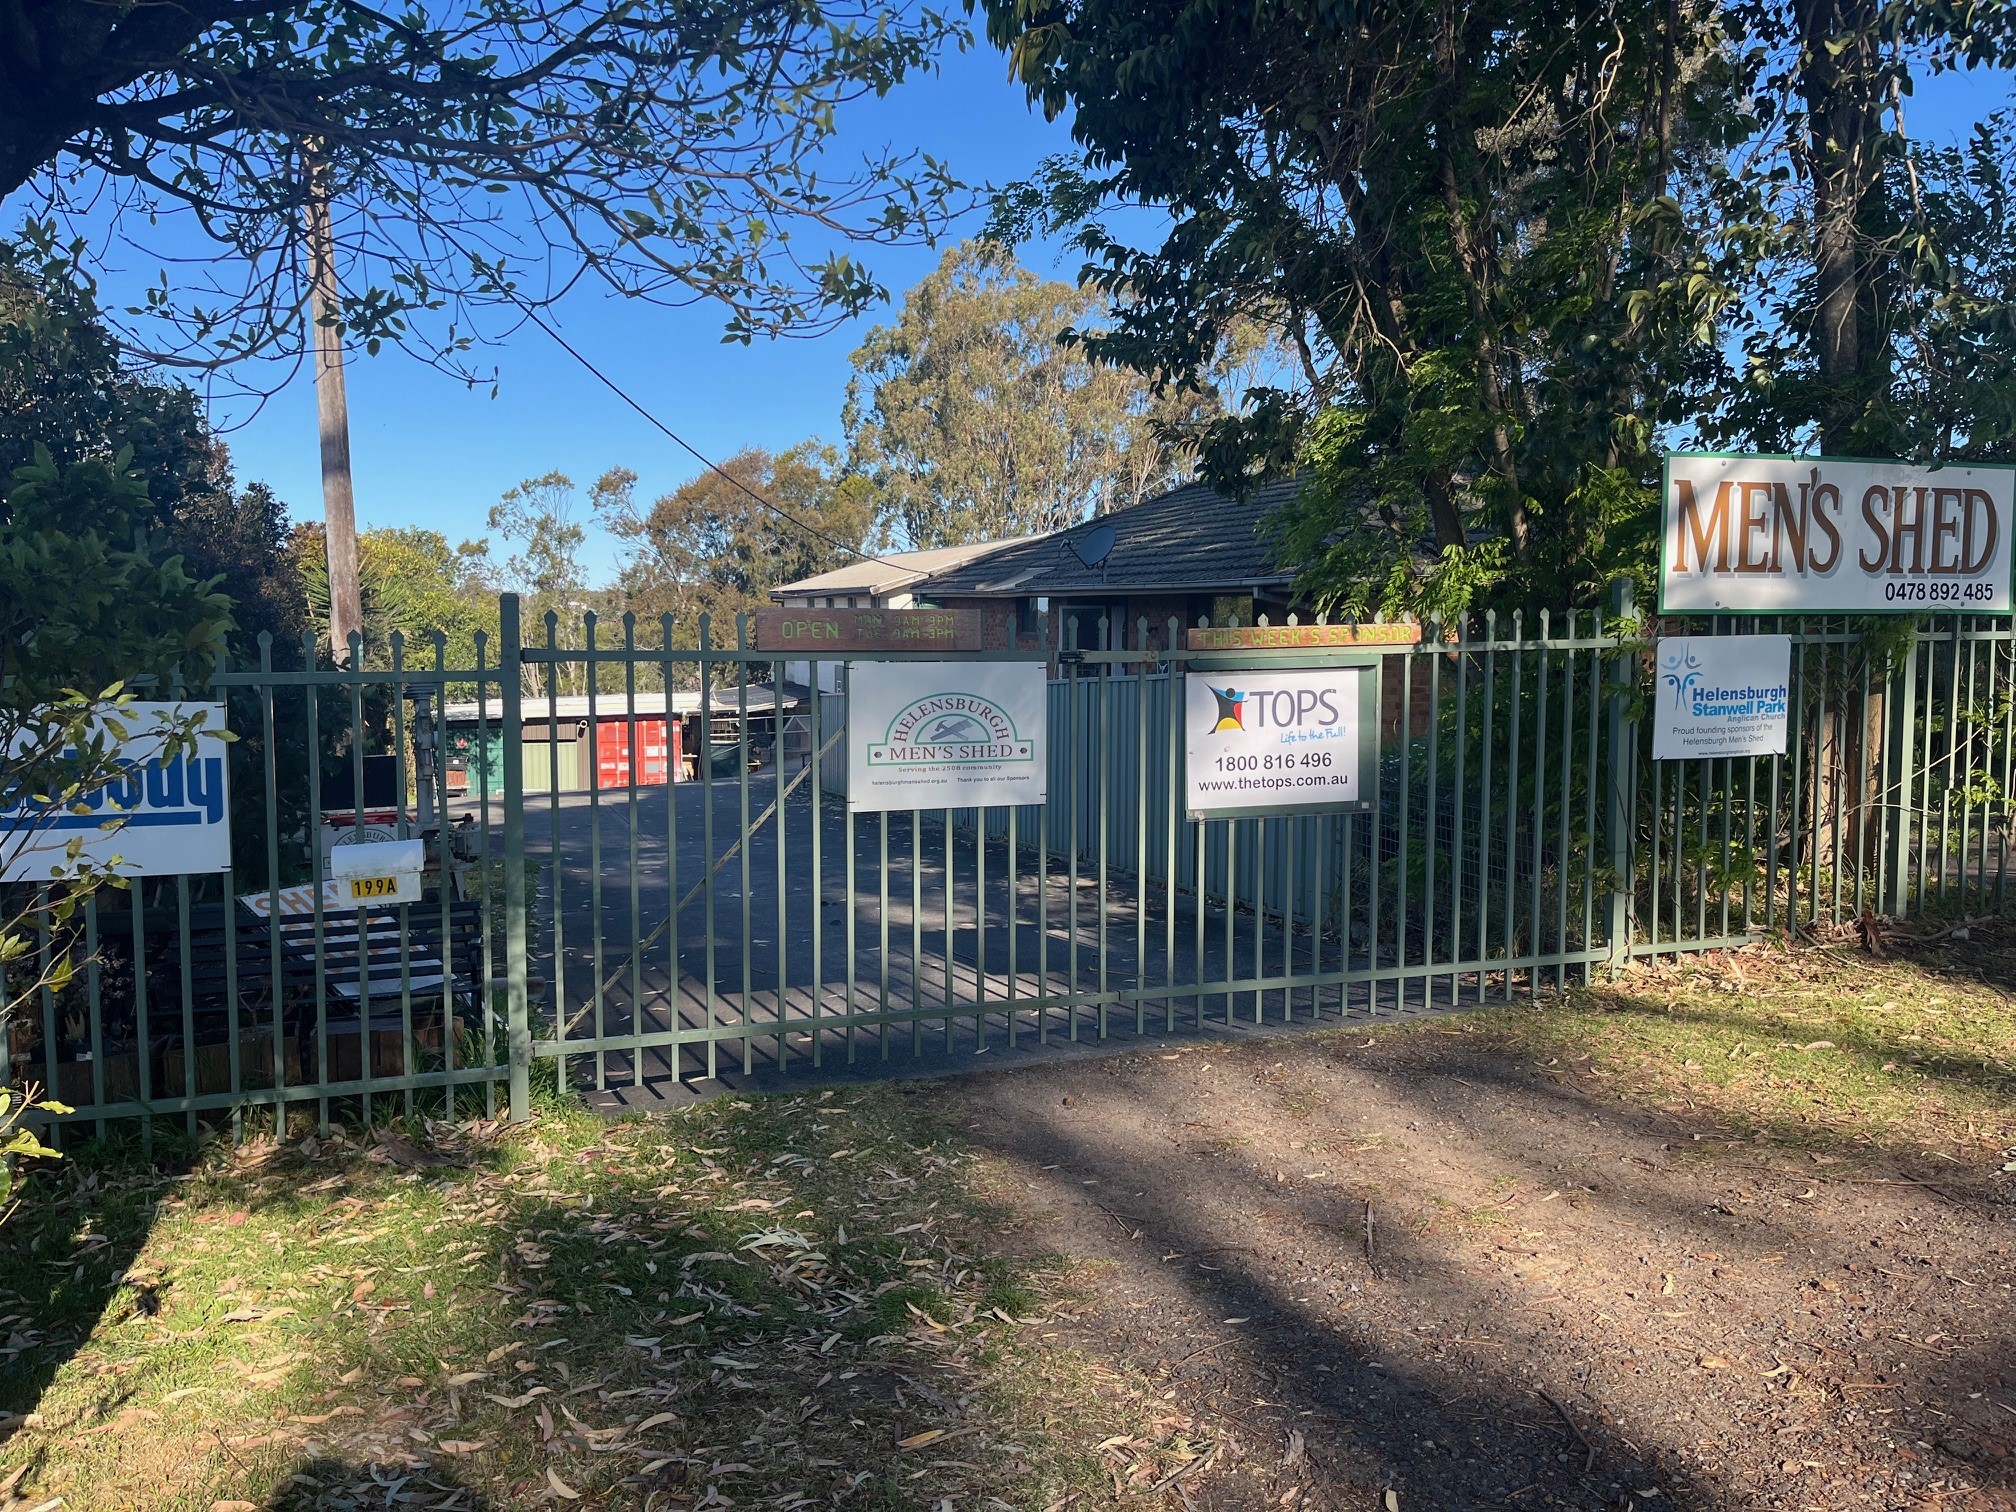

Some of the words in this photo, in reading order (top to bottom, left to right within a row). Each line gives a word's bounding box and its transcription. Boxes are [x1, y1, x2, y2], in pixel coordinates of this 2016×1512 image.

[1672, 467, 1842, 579] MEN'S
[1858, 484, 2000, 579] SHED
[1885, 582, 1926, 601] 0478
[1929, 582, 1960, 601] 892
[1963, 582, 1993, 601] 485
[781, 620, 840, 640] OPEN
[1200, 630, 1243, 647] THIS
[1251, 629, 1321, 646] WEEK'S
[1329, 626, 1413, 645] SPONSOR
[1692, 684, 1786, 701] Helensburgh
[1249, 688, 1339, 728] TOPS
[1692, 700, 1754, 717] Stanwell
[1757, 698, 1786, 713] Park
[893, 697, 1010, 743] HELENSBURGH
[1727, 715, 1759, 724] Anglican
[1760, 712, 1786, 721] Church
[1280, 730, 1297, 746] Life
[1298, 732, 1308, 743] to
[1309, 730, 1324, 741] the
[1325, 726, 1346, 739] Full!
[1672, 726, 1695, 735] Proud
[1696, 725, 1726, 736] founding
[1727, 724, 1756, 734] sponsors
[1756, 723, 1763, 732] of
[1763, 723, 1773, 731] the
[1683, 736, 1727, 747] Helensburgh
[1728, 735, 1746, 743] Men's
[1748, 734, 1764, 742] Shed
[889, 745, 953, 761] MEN'S
[959, 743, 1013, 759] SHED
[1215, 755, 1258, 772] 1800
[1263, 753, 1295, 770] 816
[1300, 752, 1333, 768] 496
[1198, 774, 1348, 791] www.thetops.com.au
[354, 878, 397, 896] 199A
